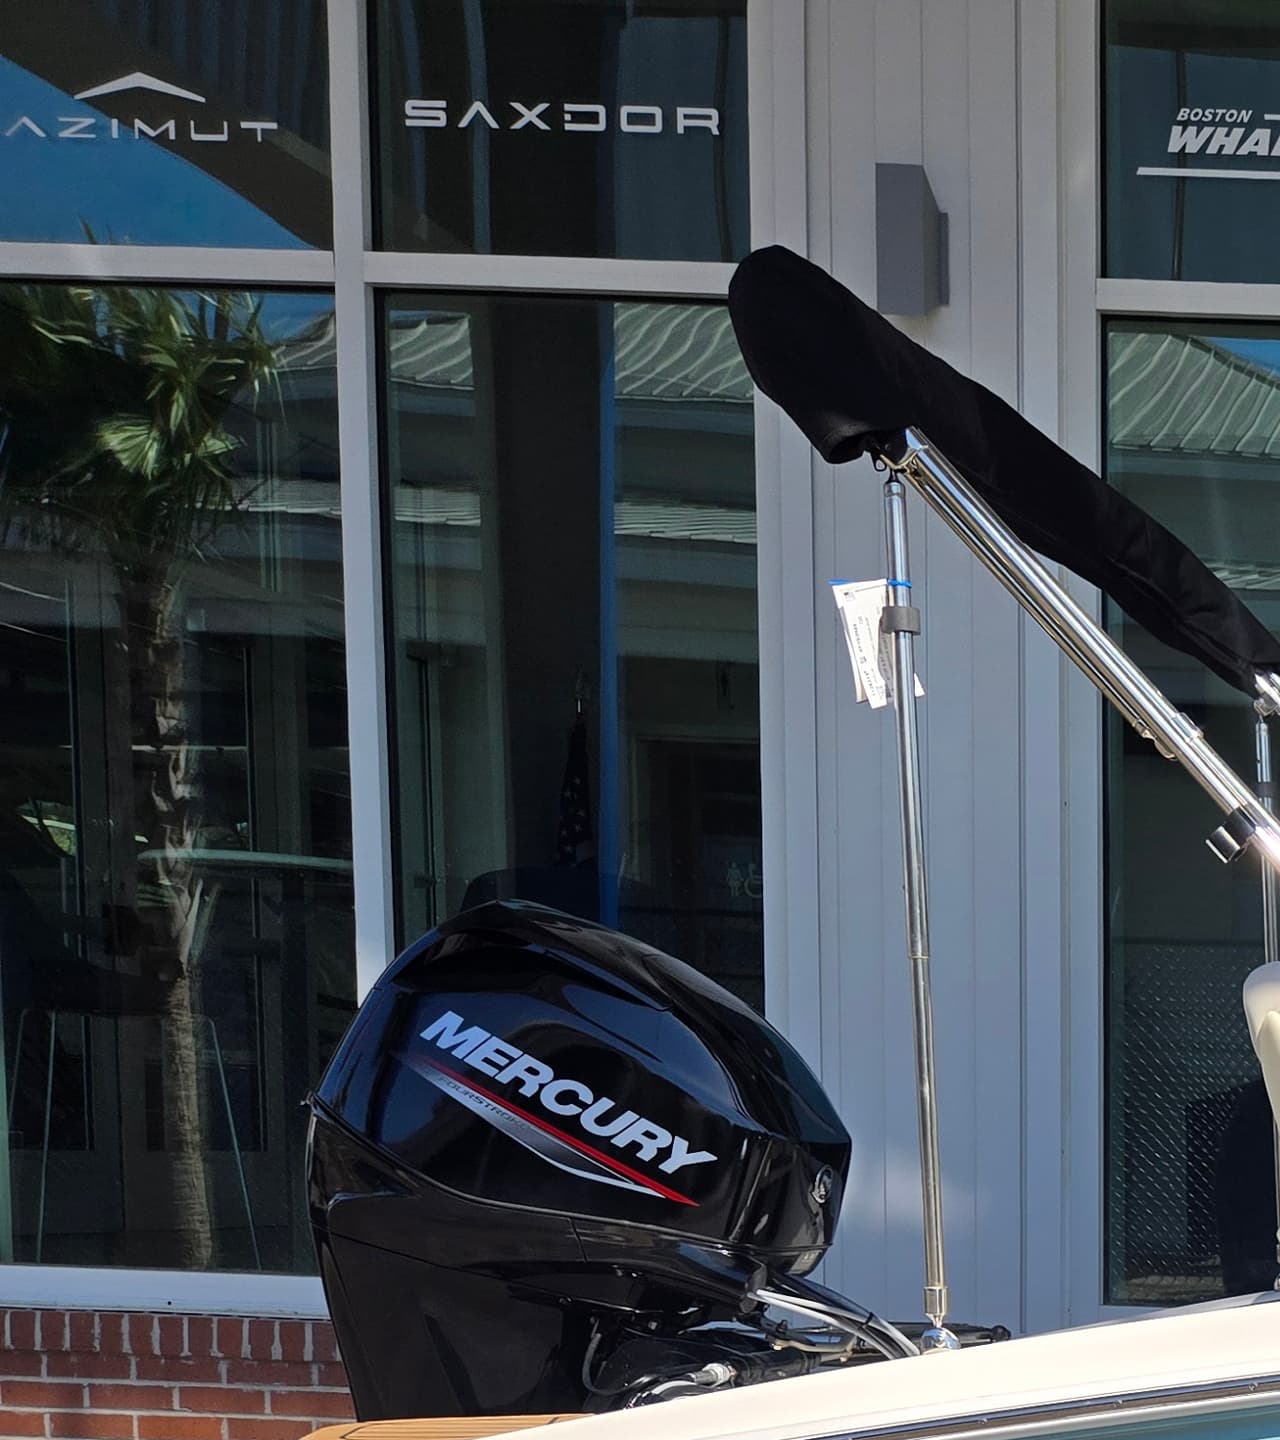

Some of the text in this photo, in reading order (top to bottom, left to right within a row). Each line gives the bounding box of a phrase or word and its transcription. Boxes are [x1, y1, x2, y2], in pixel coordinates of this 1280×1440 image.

[4, 115, 279, 142] AZIMUT
[404, 99, 720, 135] SAXDOR
[1176, 108, 1253, 123] BOSTON
[419, 1010, 718, 1175] MERCURY
